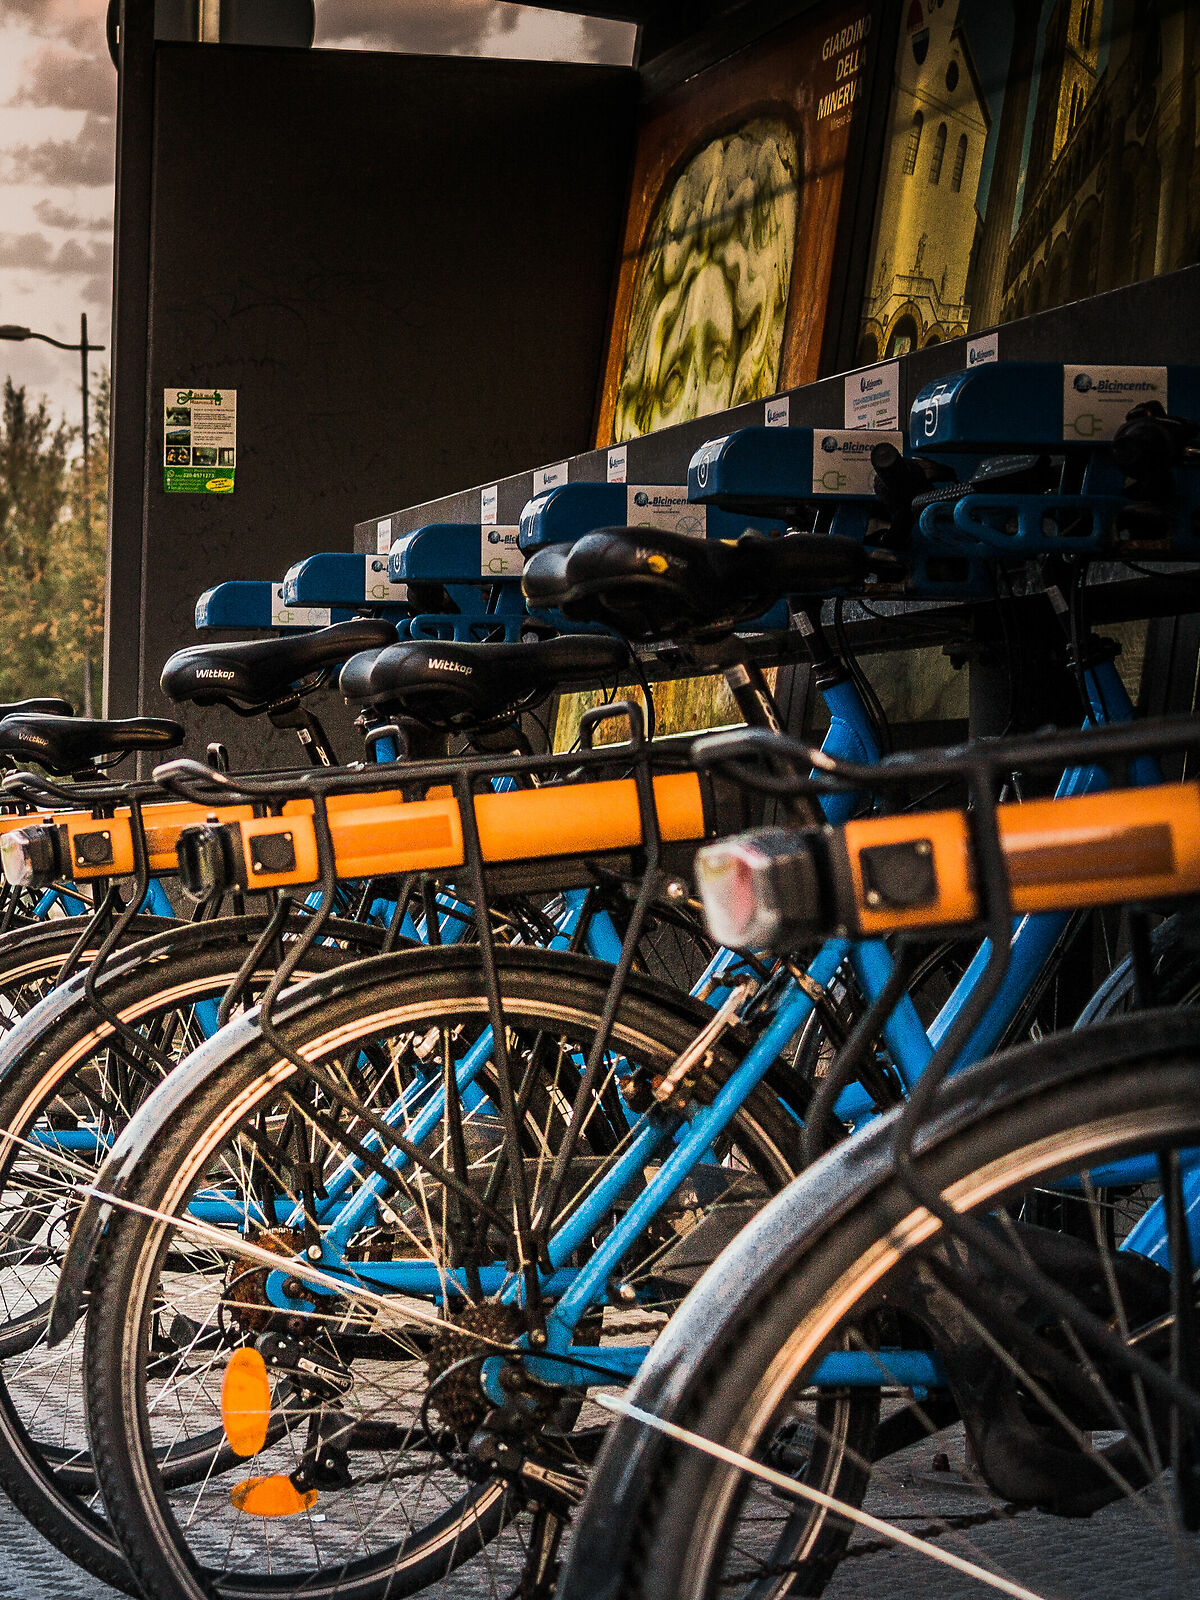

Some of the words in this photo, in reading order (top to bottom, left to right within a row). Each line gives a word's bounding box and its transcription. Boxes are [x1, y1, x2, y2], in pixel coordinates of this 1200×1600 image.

[822, 13, 872, 62] GIARDINO
[835, 45, 867, 82] DELLA
[816, 76, 863, 121] MINERVA
[195, 669, 235, 681] Wittkop
[428, 658, 473, 676] Wittkop
